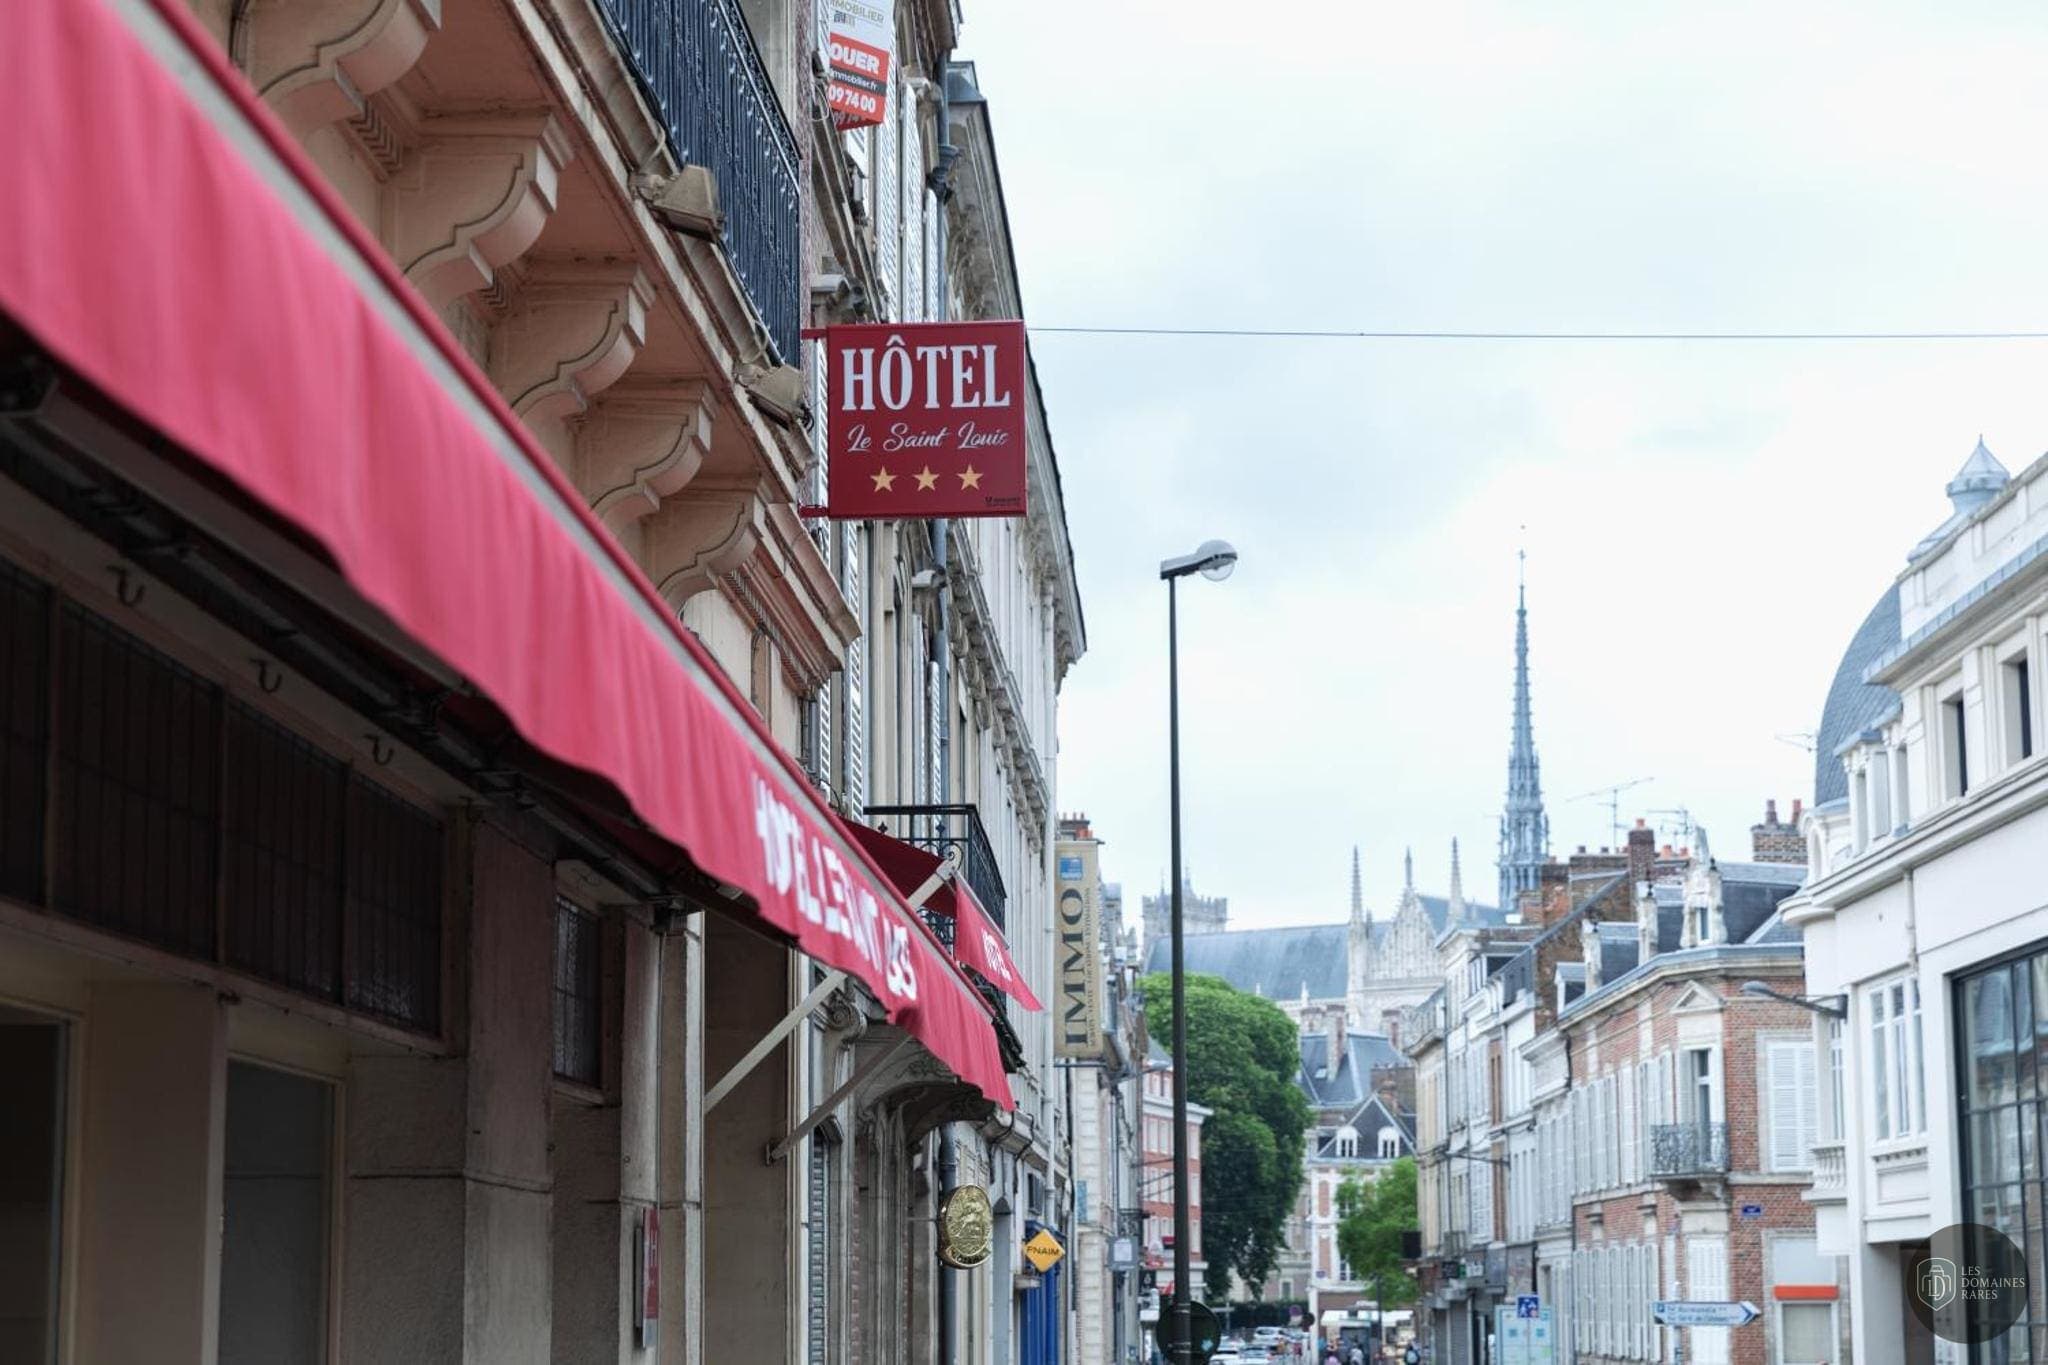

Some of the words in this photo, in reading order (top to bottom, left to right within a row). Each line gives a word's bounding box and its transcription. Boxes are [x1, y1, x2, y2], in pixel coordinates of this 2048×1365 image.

[842, 334, 1010, 411] HÔTEL
[847, 424, 872, 452] Le
[883, 422, 951, 451] Saint
[958, 421, 1009, 449] Louis
[1060, 888, 1089, 1047] IMMO
[1026, 1245, 1060, 1256] FNAIM
